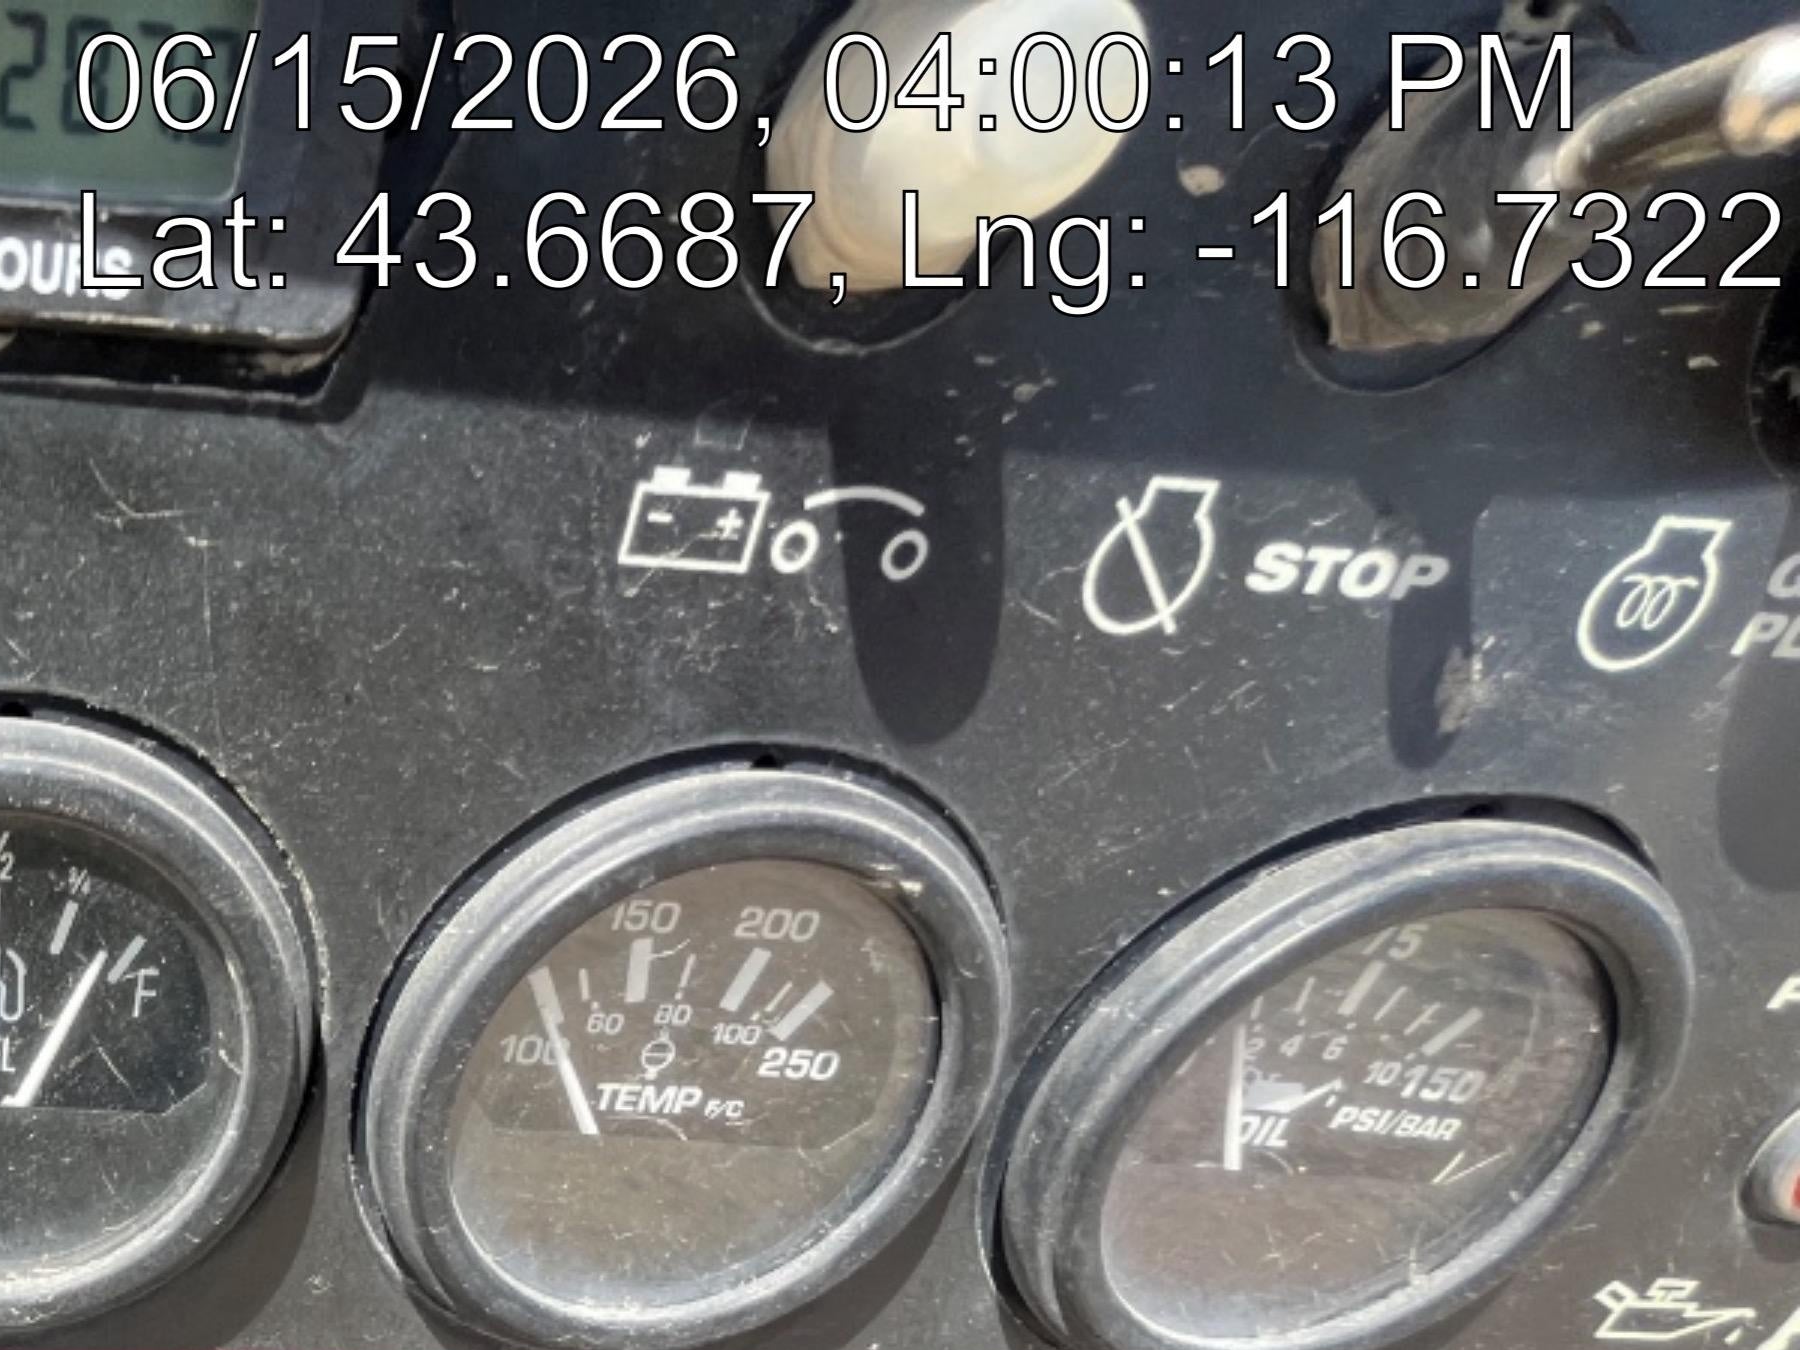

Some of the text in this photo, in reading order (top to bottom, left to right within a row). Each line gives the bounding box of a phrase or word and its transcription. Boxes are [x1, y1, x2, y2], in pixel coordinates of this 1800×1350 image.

[1245, 542, 1450, 600] STOP
[611, 902, 682, 934] 150
[734, 906, 819, 942] 200
[132, 968, 160, 1017] F
[712, 1024, 762, 1045] 100
[757, 1048, 840, 1081] 250
[1321, 1036, 1348, 1060] 6
[1400, 1065, 1486, 1104] 150
[597, 1083, 703, 1114] TEMP
[1328, 1106, 1463, 1141] PSI/BAR
